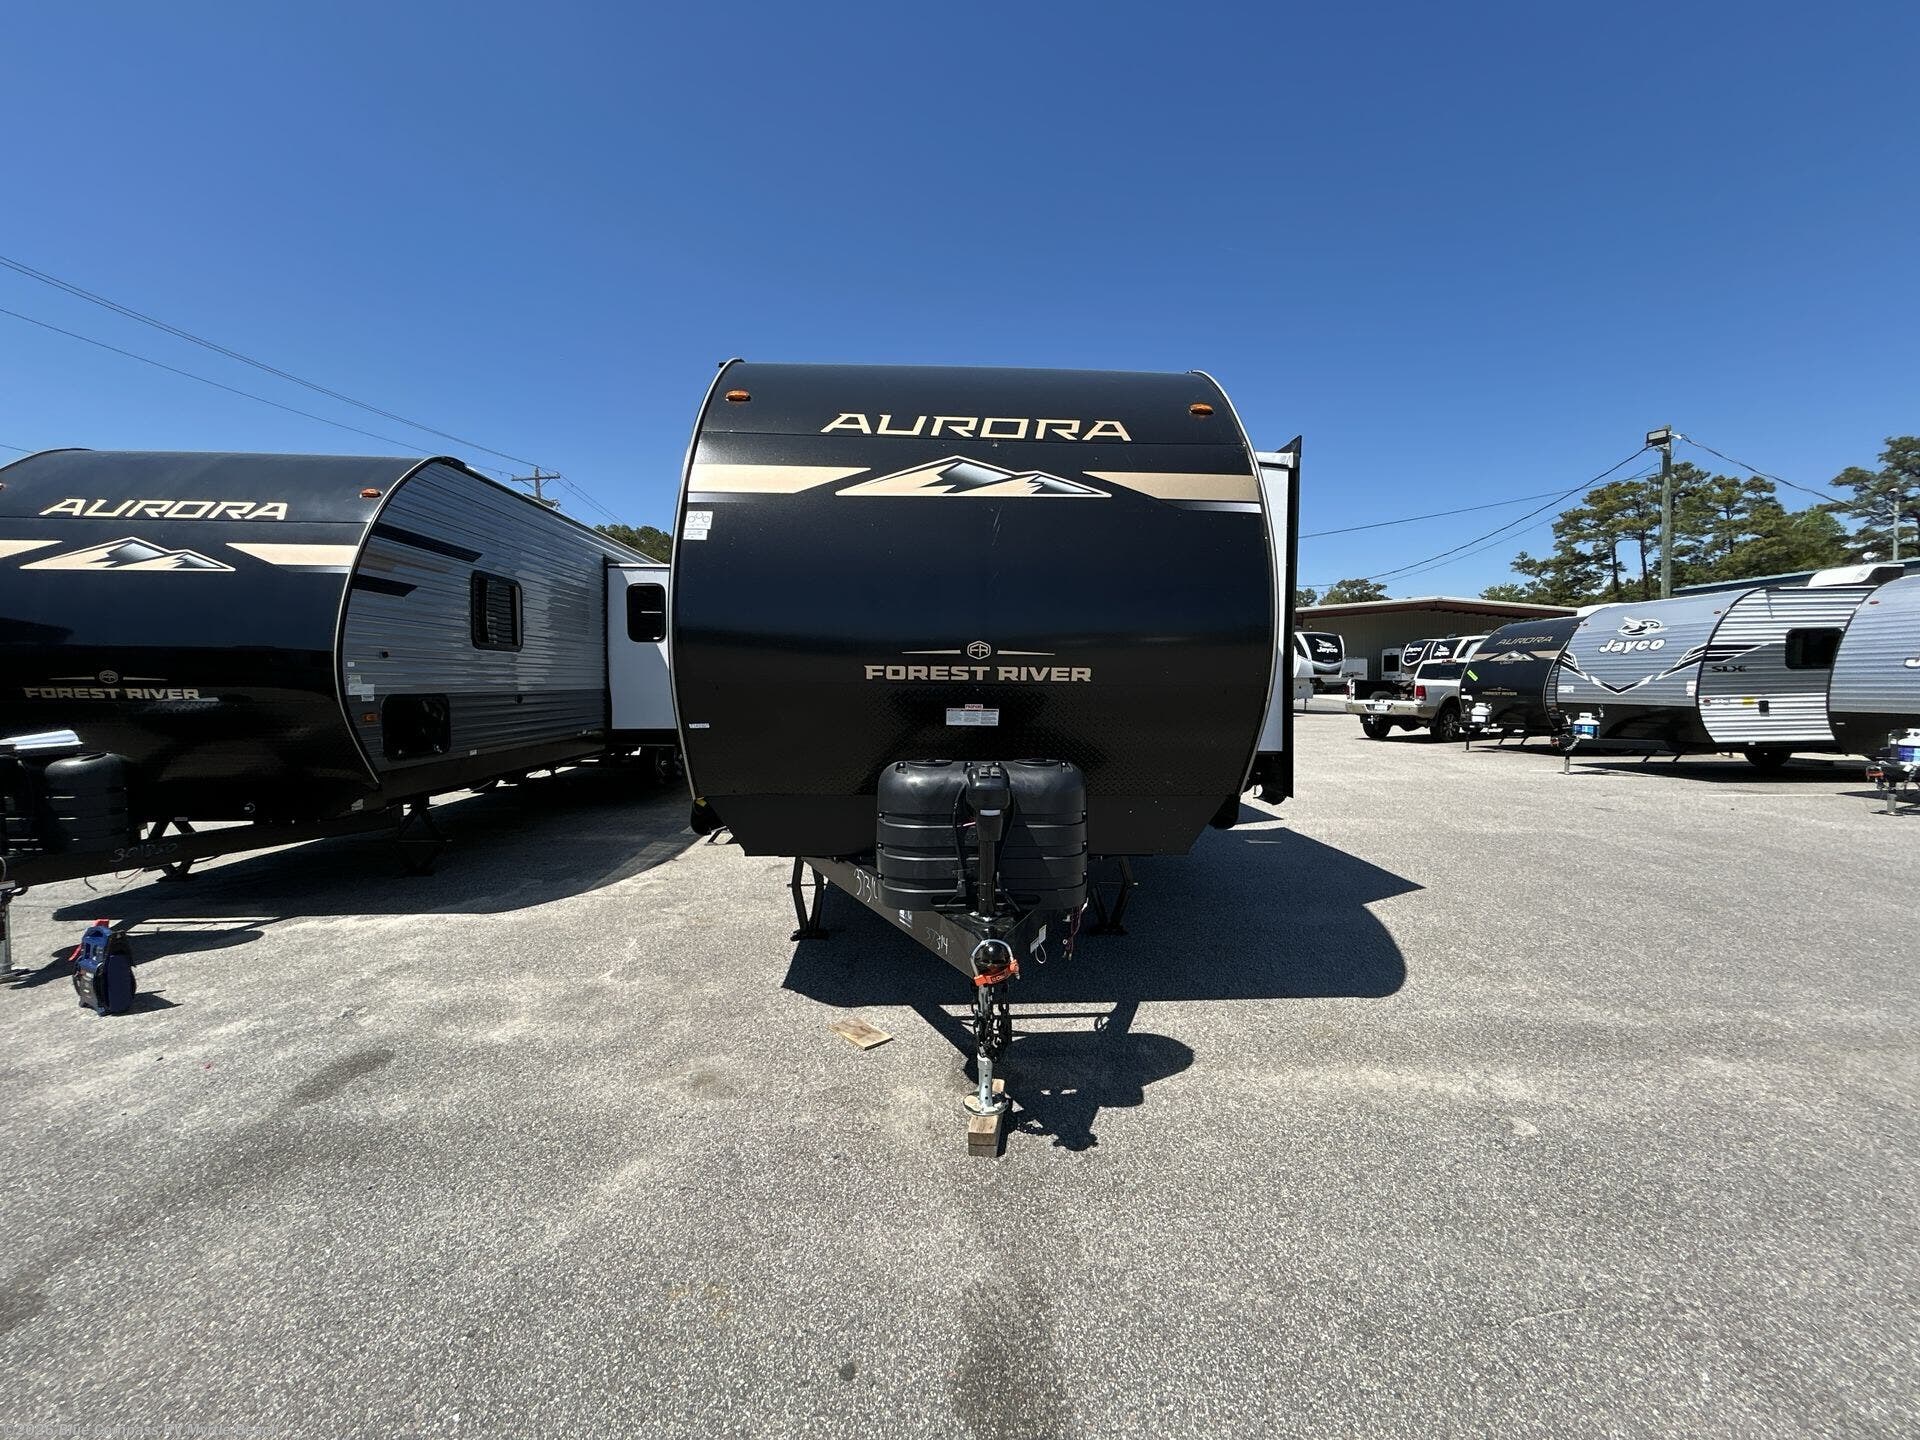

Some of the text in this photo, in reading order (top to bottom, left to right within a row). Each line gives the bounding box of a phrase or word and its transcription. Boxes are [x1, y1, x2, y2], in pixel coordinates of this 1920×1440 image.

[820, 412, 1133, 442] AURORA
[39, 498, 288, 521] AURORA
[1496, 636, 1554, 646] AURORA
[1598, 639, 1666, 655] Jayco
[1316, 646, 1339, 654] Jayco
[864, 665, 1092, 682] FOREST RIVER
[23, 687, 201, 701] FOREST RIVER
